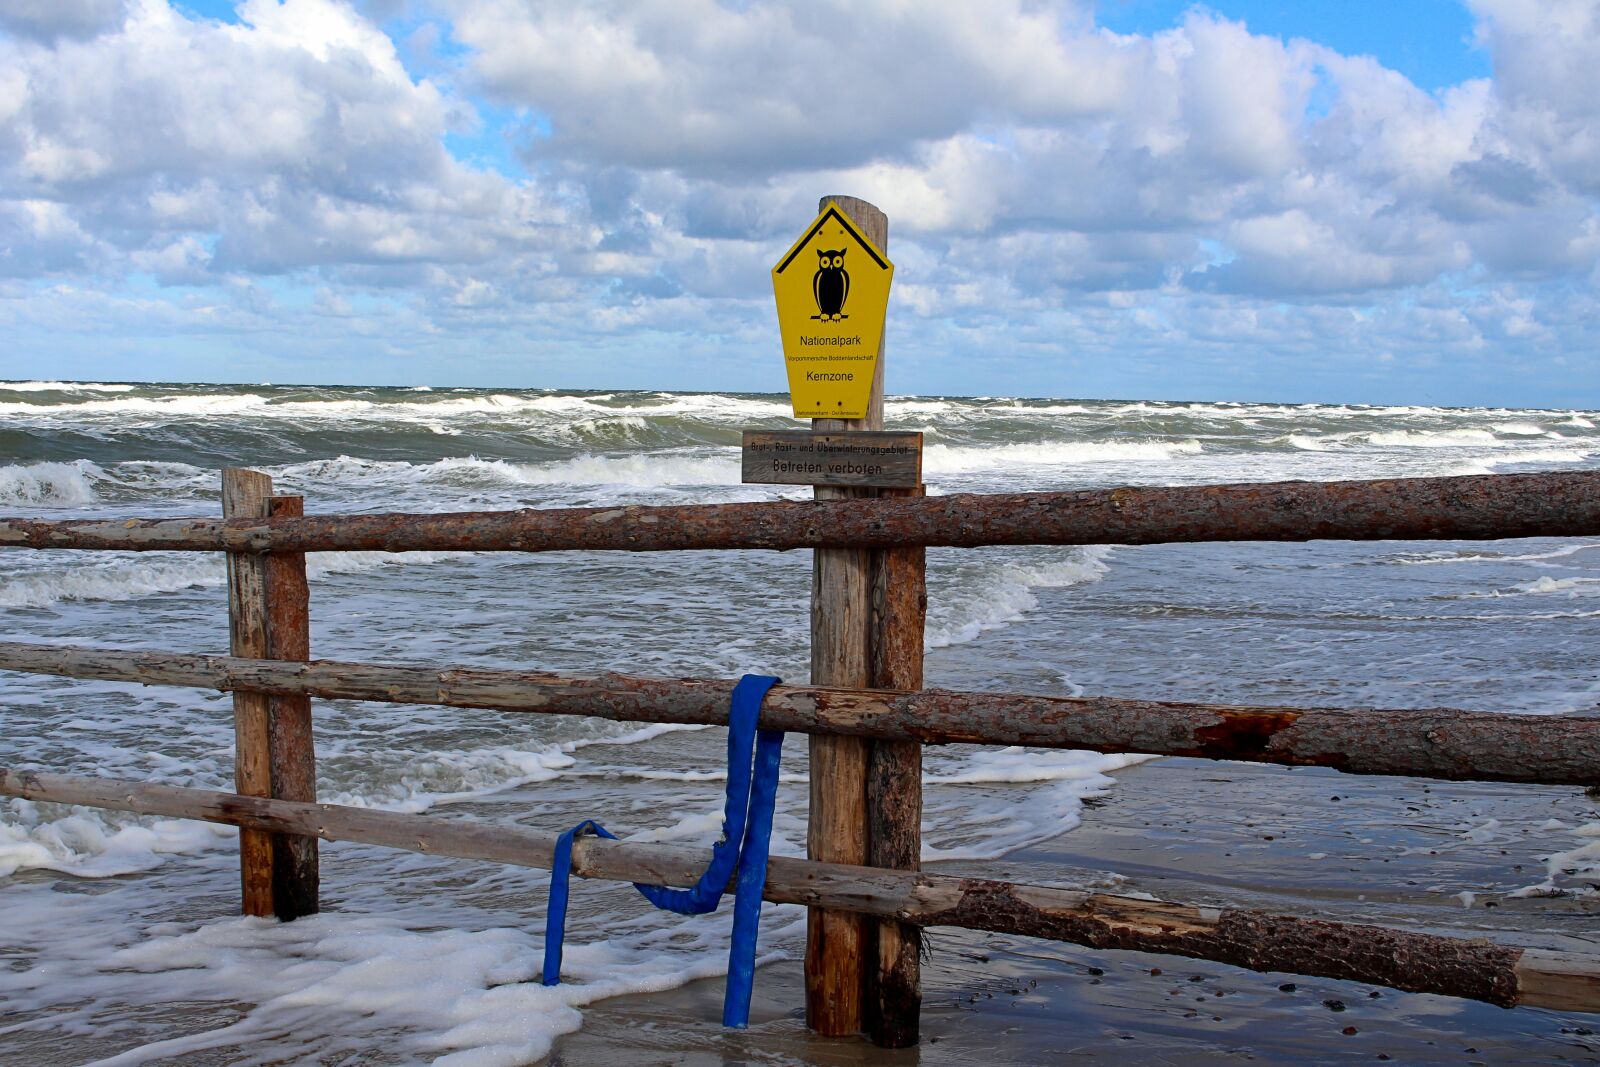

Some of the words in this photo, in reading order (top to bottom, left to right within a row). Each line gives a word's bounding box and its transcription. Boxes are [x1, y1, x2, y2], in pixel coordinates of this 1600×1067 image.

[800, 335, 861, 347] Nationalpark
[806, 371, 854, 381] Kernzone
[775, 442, 797, 451] Rast-
[799, 443, 814, 453] und
[817, 442, 908, 456] Überwinterungsgebiet
[773, 459, 822, 472] Betreten
[828, 461, 882, 474] verboten
